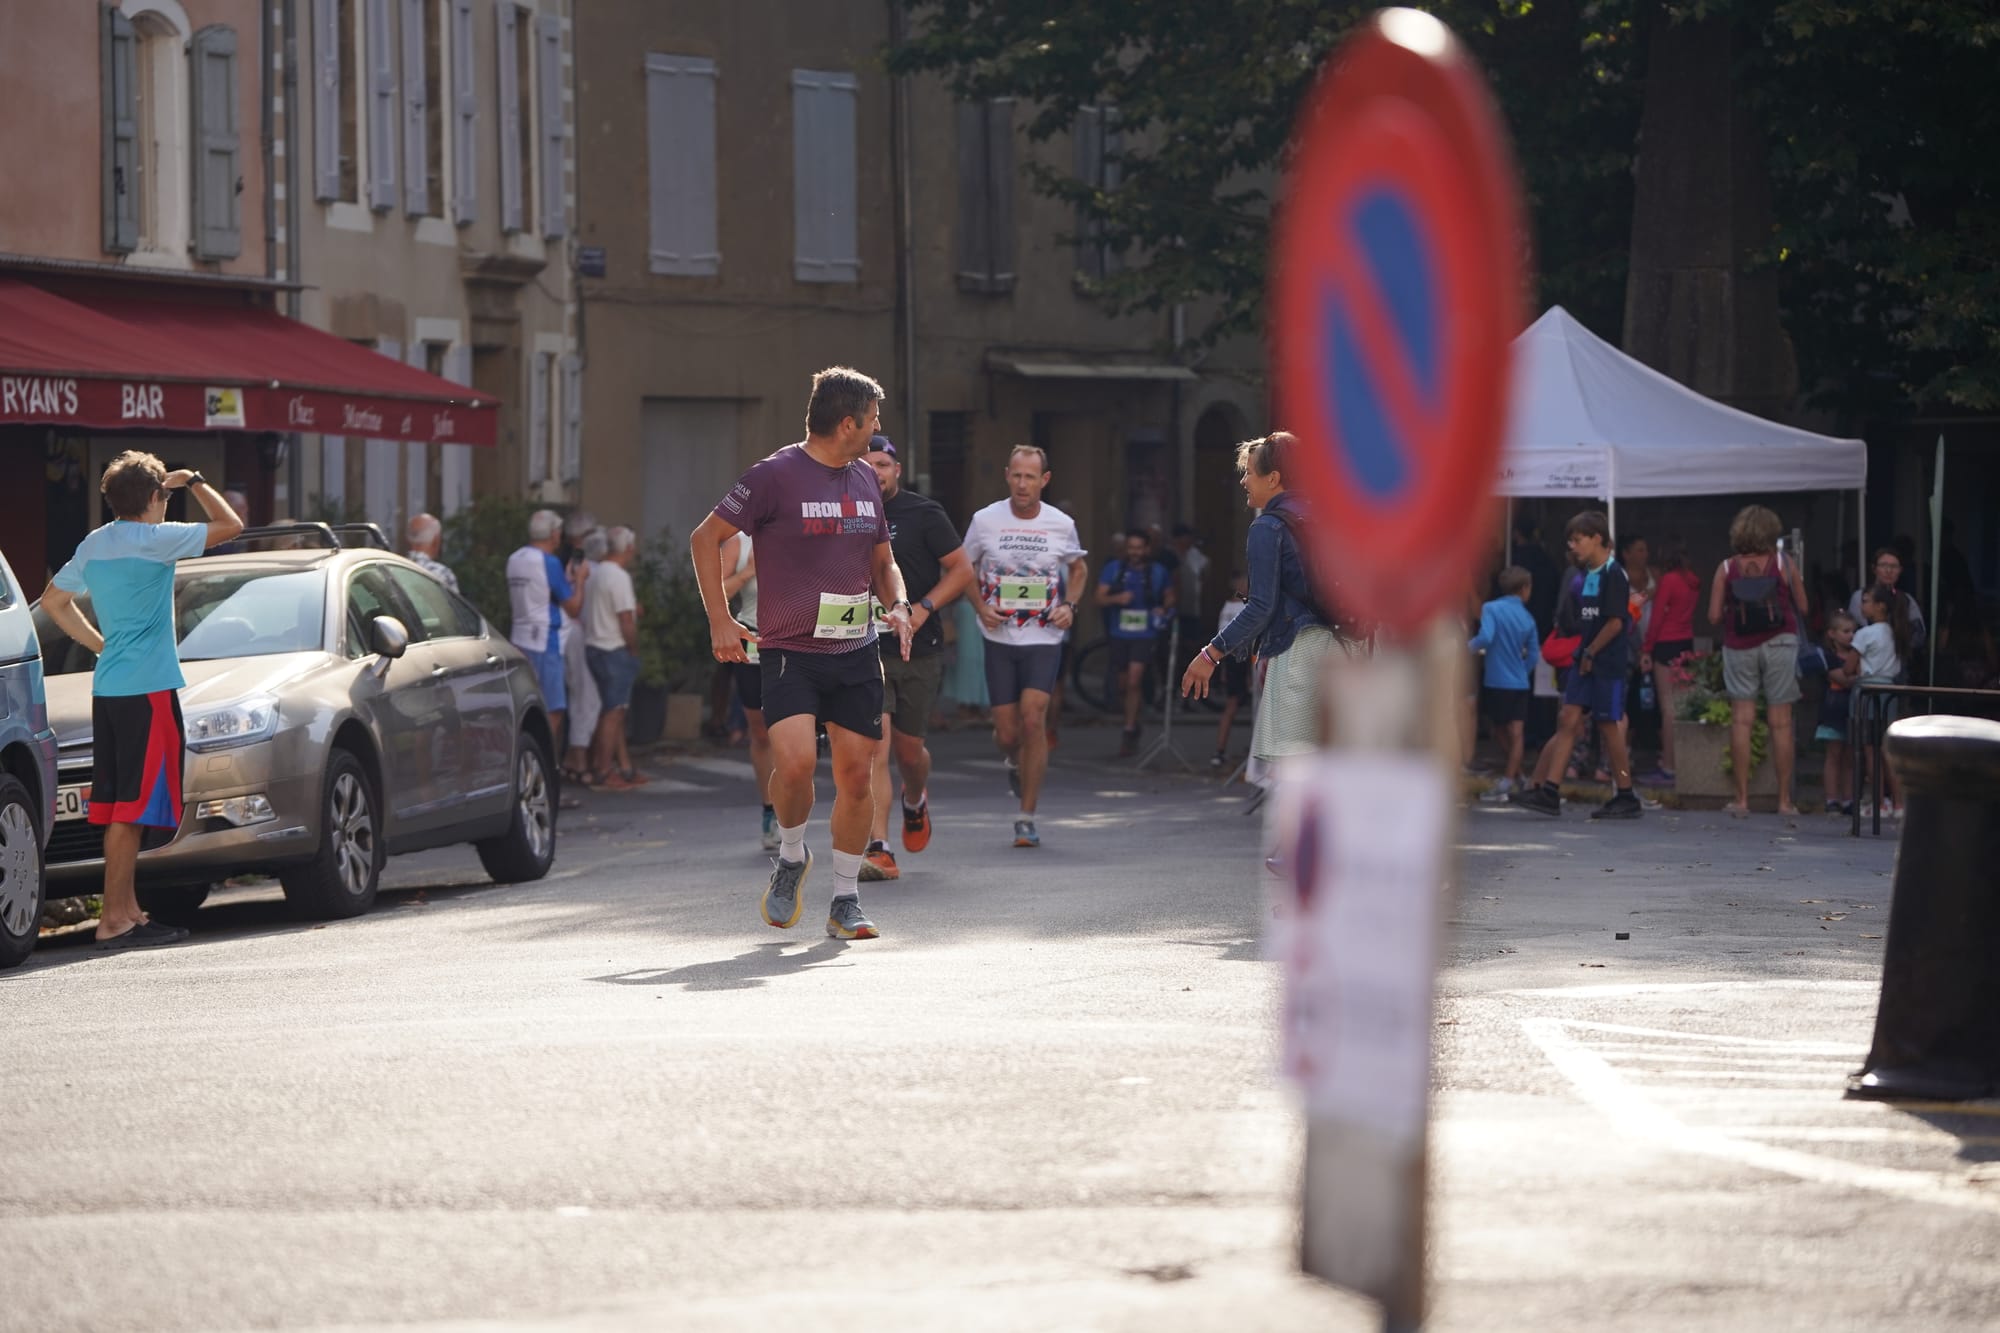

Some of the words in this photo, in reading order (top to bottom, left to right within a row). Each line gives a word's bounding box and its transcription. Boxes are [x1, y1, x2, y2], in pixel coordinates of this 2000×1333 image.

[2, 378, 78, 415] RYAN'S
[122, 384, 165, 419] BAR
[801, 498, 876, 518] IRONMAN
[802, 518, 835, 535] 70.3
[1018, 585, 1029, 599] 2
[840, 607, 855, 624] 4
